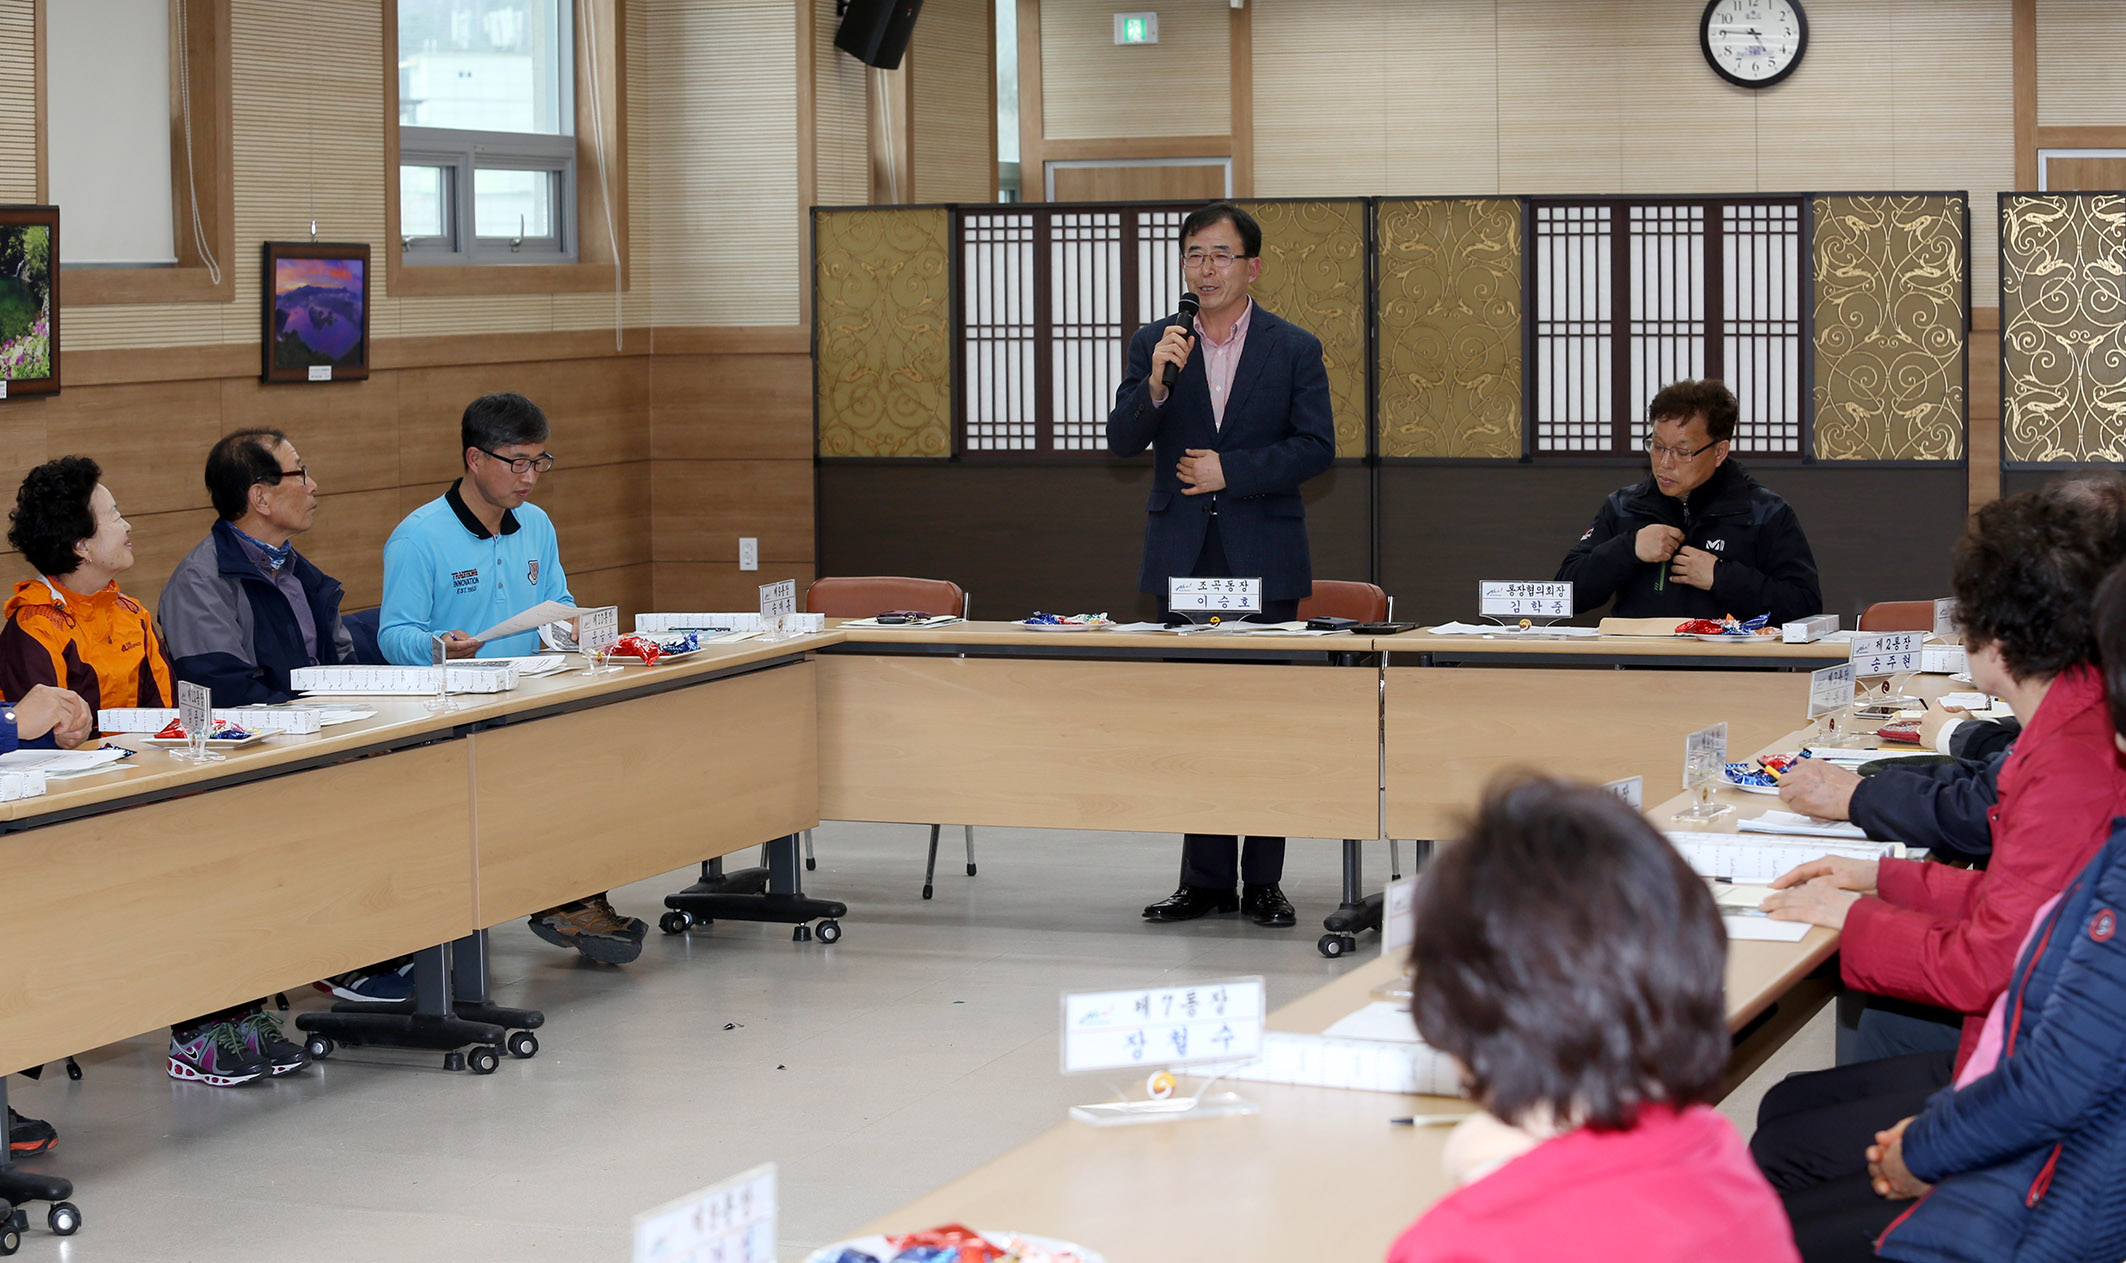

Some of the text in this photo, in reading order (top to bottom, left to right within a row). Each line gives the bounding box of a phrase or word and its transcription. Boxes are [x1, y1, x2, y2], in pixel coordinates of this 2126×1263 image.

[1721, 13, 1733, 24] 10
[1779, 11, 1786, 22] 2
[1719, 29, 1727, 40] 9
[1783, 27, 1791, 38] 3
[1723, 45, 1732, 56] 8
[1735, 57, 1742, 68] 7
[1752, 61, 1759, 71] 6
[1768, 56, 1776, 67] 5
[1197, 579, 1249, 593] 조곡동장
[1506, 584, 1565, 598] 통장협의회장
[1197, 594, 1250, 609] 이승호
[1510, 600, 1563, 614] 김학중
[1875, 634, 1911, 652] 제2통장
[1134, 986, 1229, 1018] 제7통장
